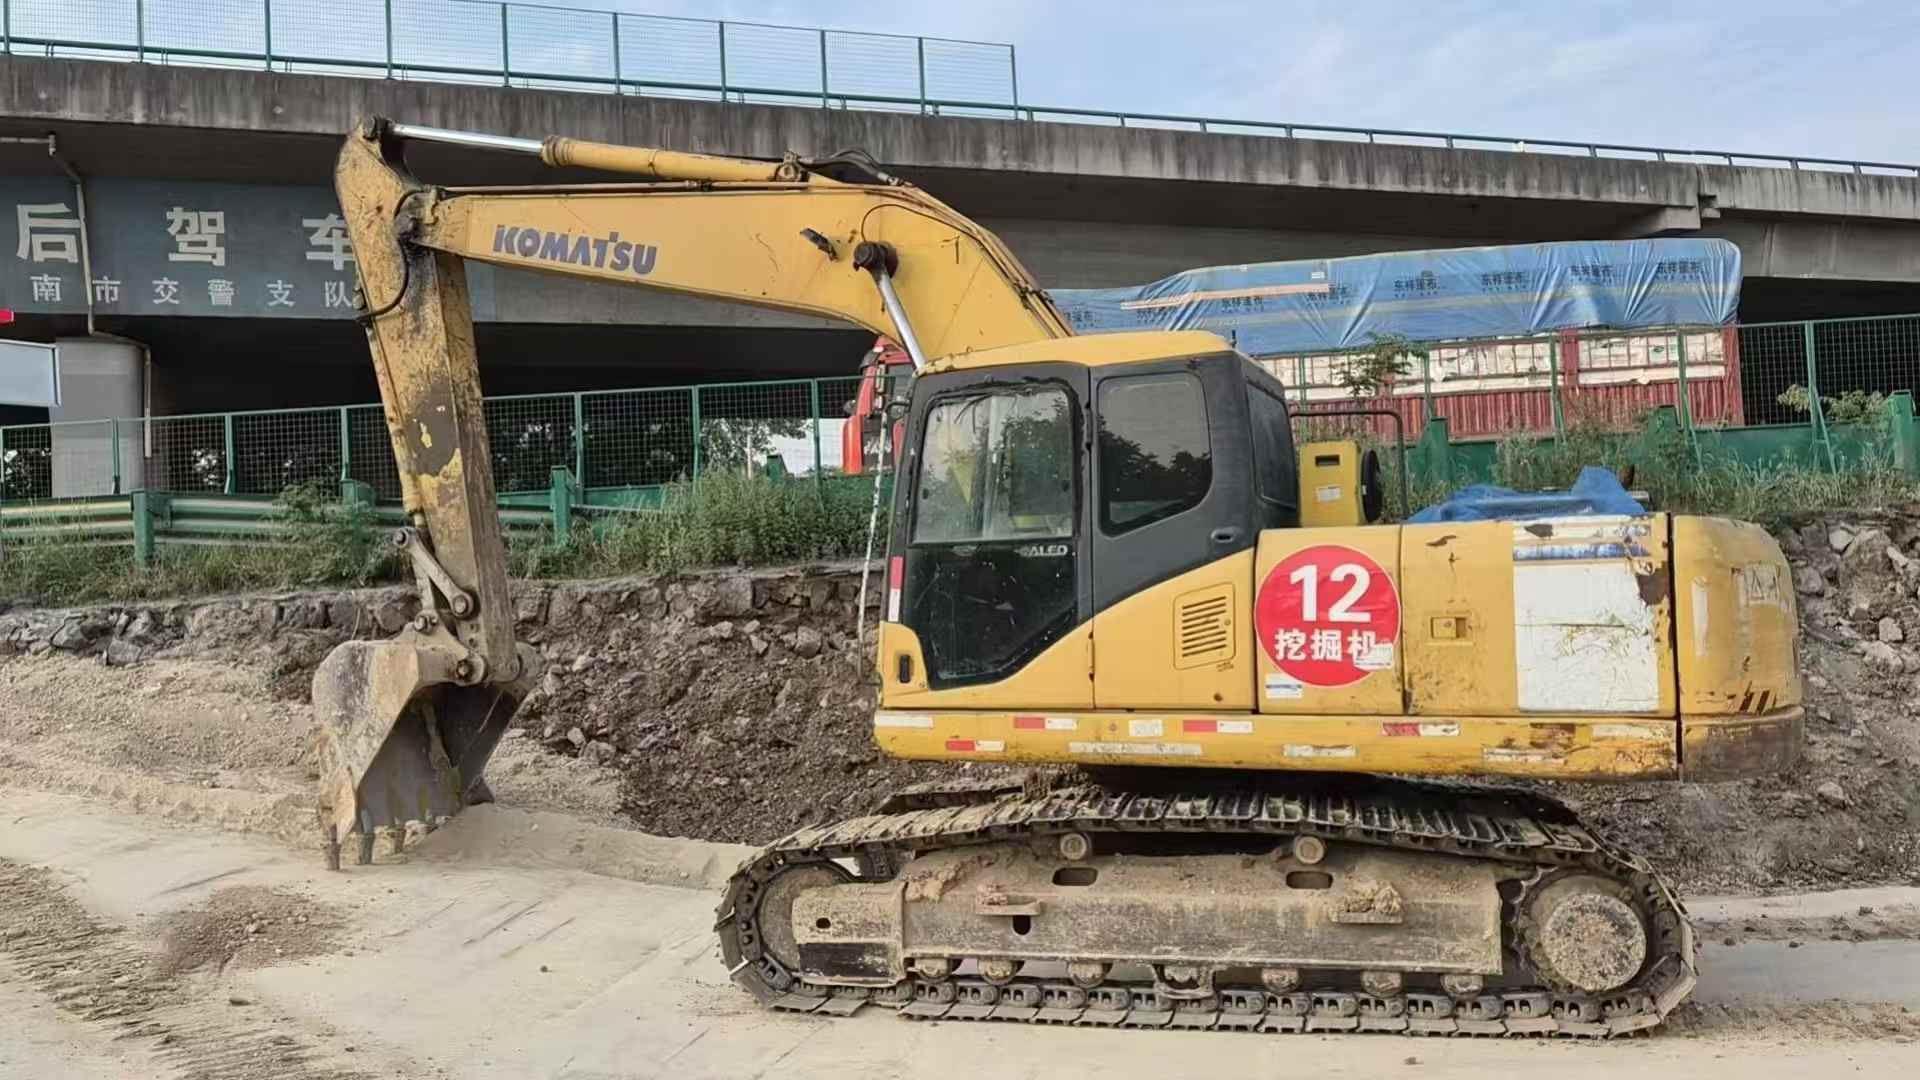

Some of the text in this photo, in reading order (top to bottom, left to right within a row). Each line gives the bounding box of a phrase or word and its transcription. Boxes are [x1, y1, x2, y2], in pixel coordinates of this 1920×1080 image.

[493, 224, 657, 275] KOMATSU
[1290, 564, 1371, 622] 12
[1275, 628, 1378, 662] 挖掘机
